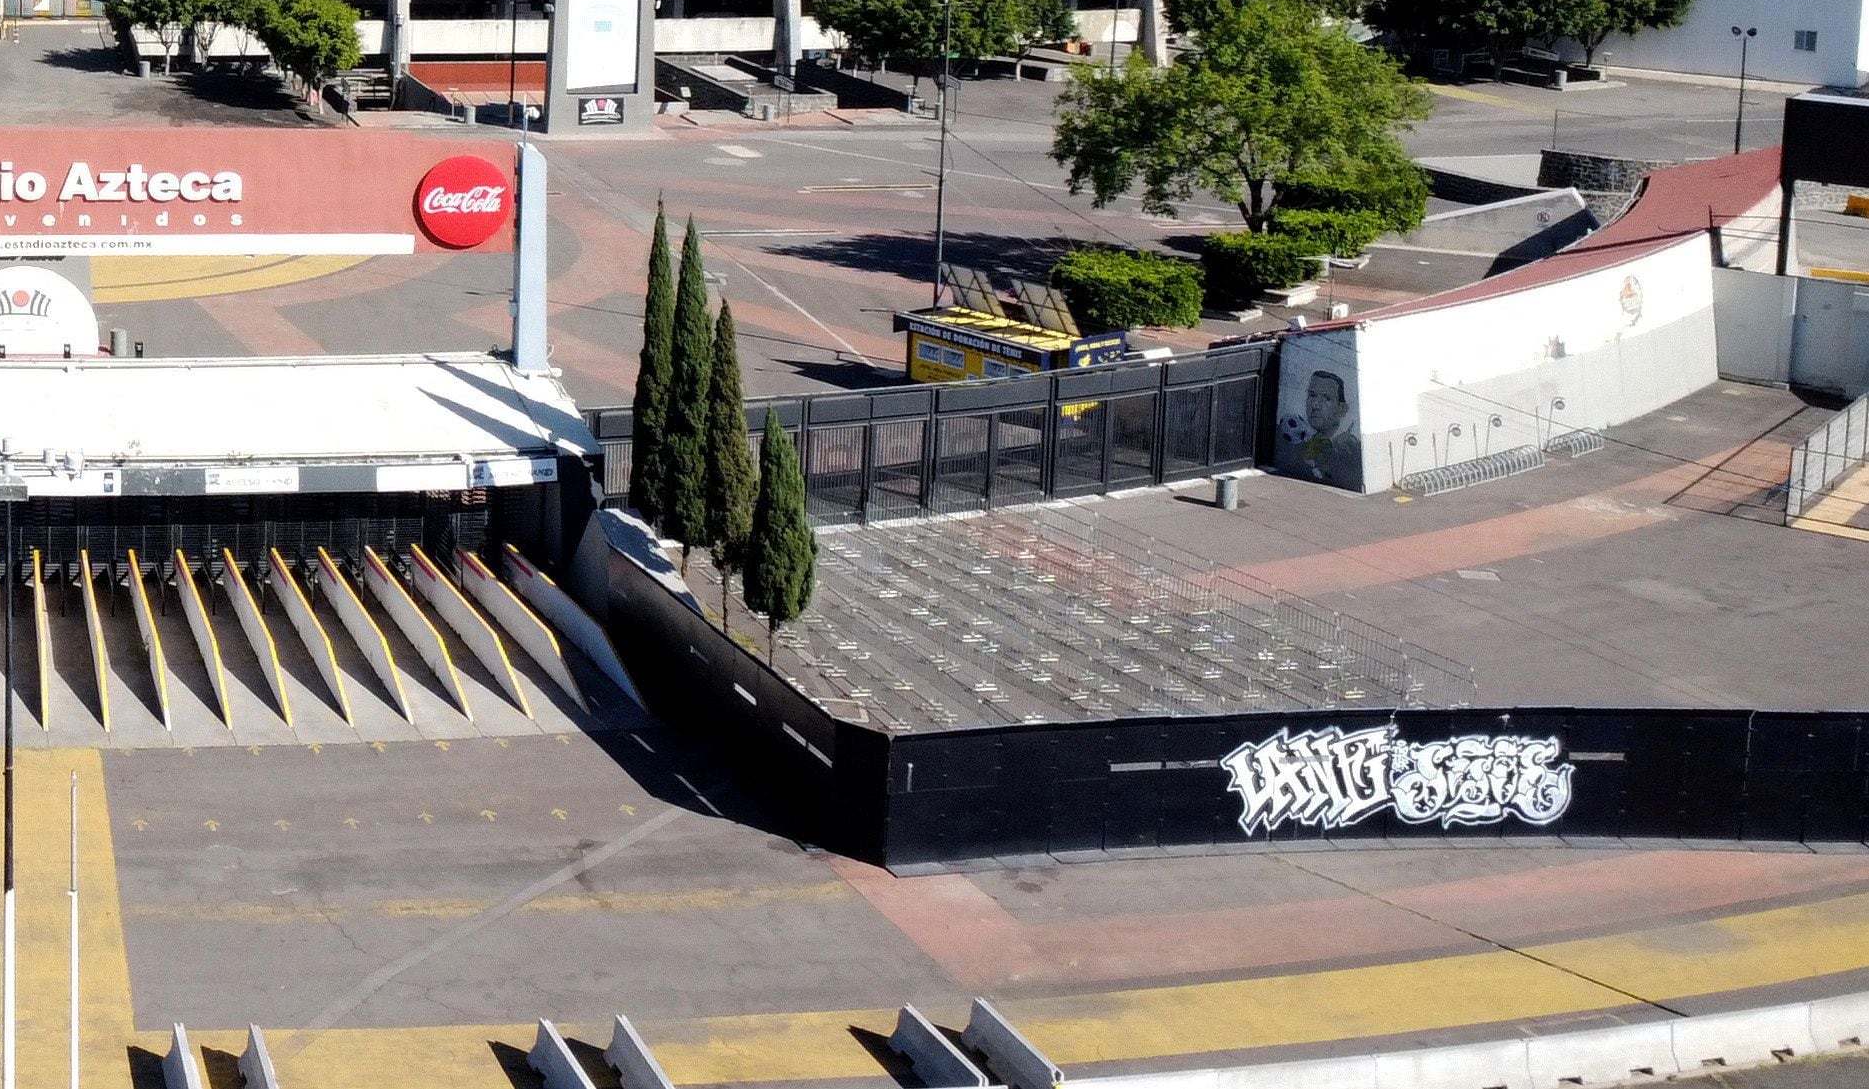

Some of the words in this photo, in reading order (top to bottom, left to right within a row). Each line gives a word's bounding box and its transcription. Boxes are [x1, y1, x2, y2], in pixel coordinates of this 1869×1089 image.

[59, 162, 243, 202] Azteca
[423, 186, 506, 214] Coca-Cola
[942, 331, 952, 341] DE
[992, 343, 1000, 354] DE
